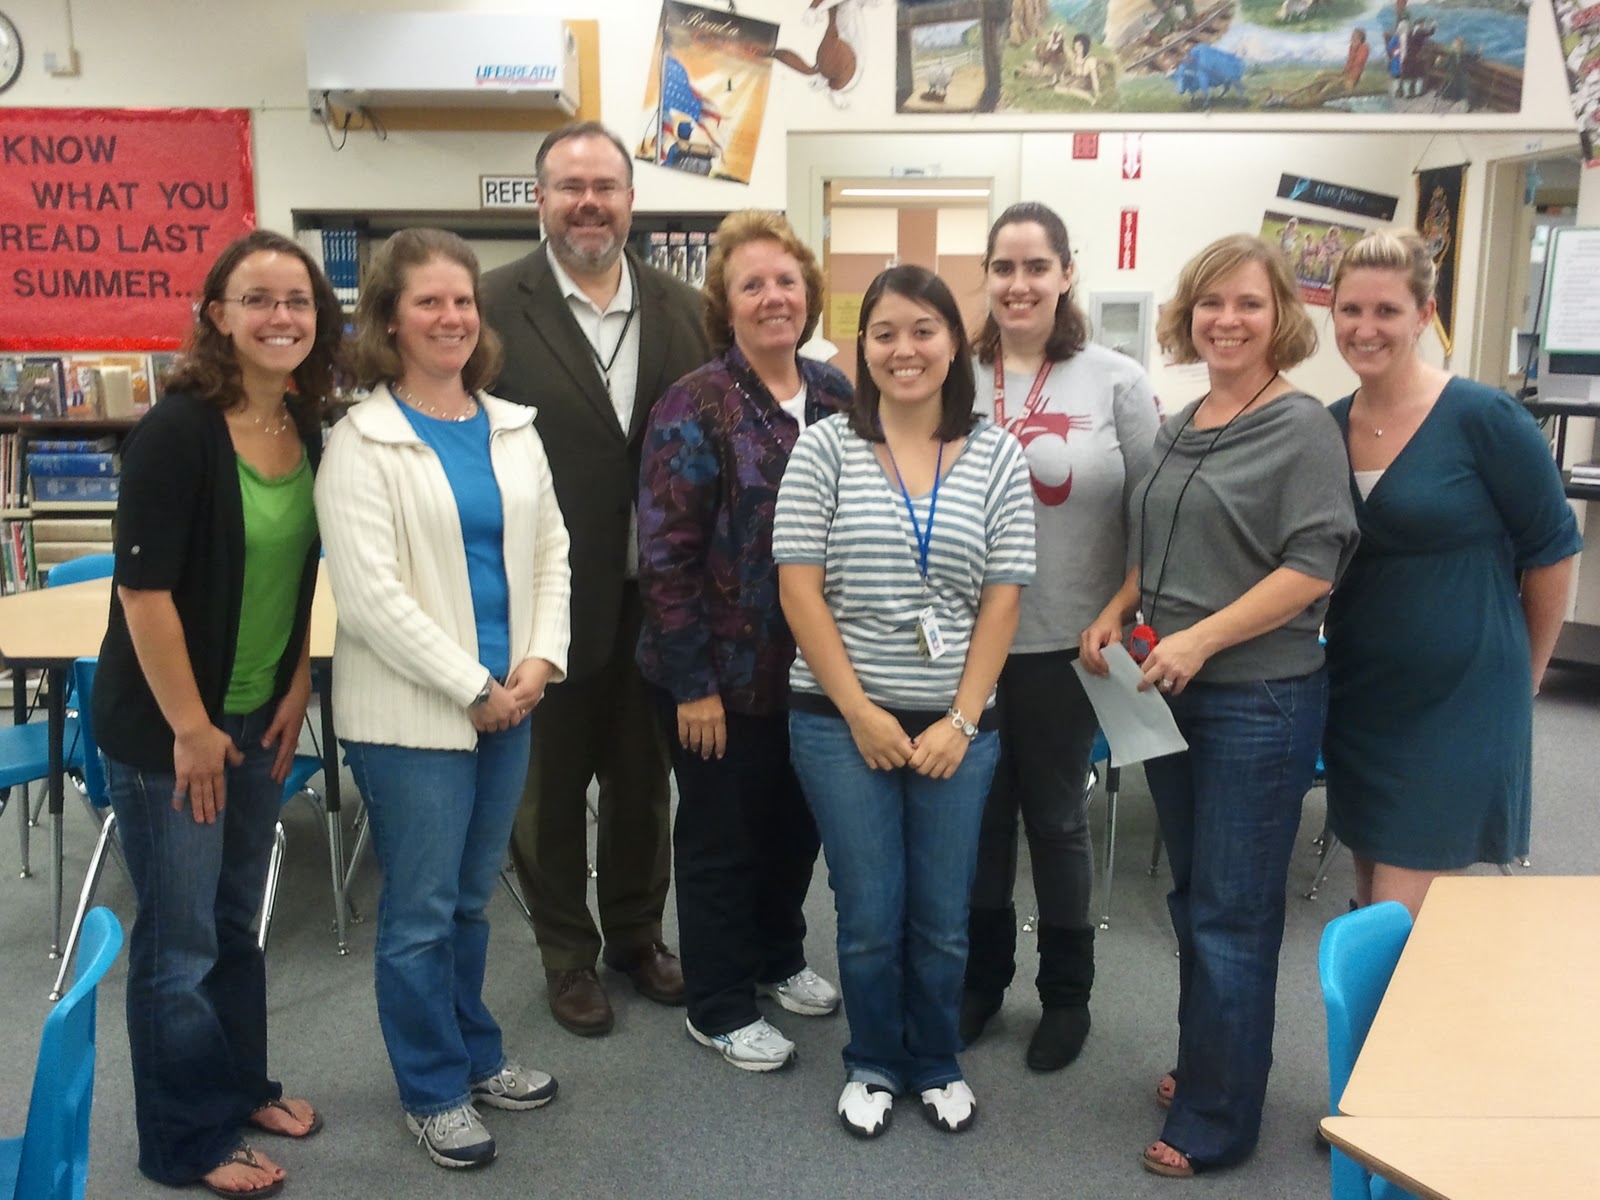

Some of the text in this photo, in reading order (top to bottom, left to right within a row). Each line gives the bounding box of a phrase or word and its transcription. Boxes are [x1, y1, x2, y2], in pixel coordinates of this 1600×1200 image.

[681, 11, 732, 33] Read
[3, 135, 117, 165] KNOW
[32, 181, 229, 211] WHAT YOU
[1, 224, 210, 253] READ LAST
